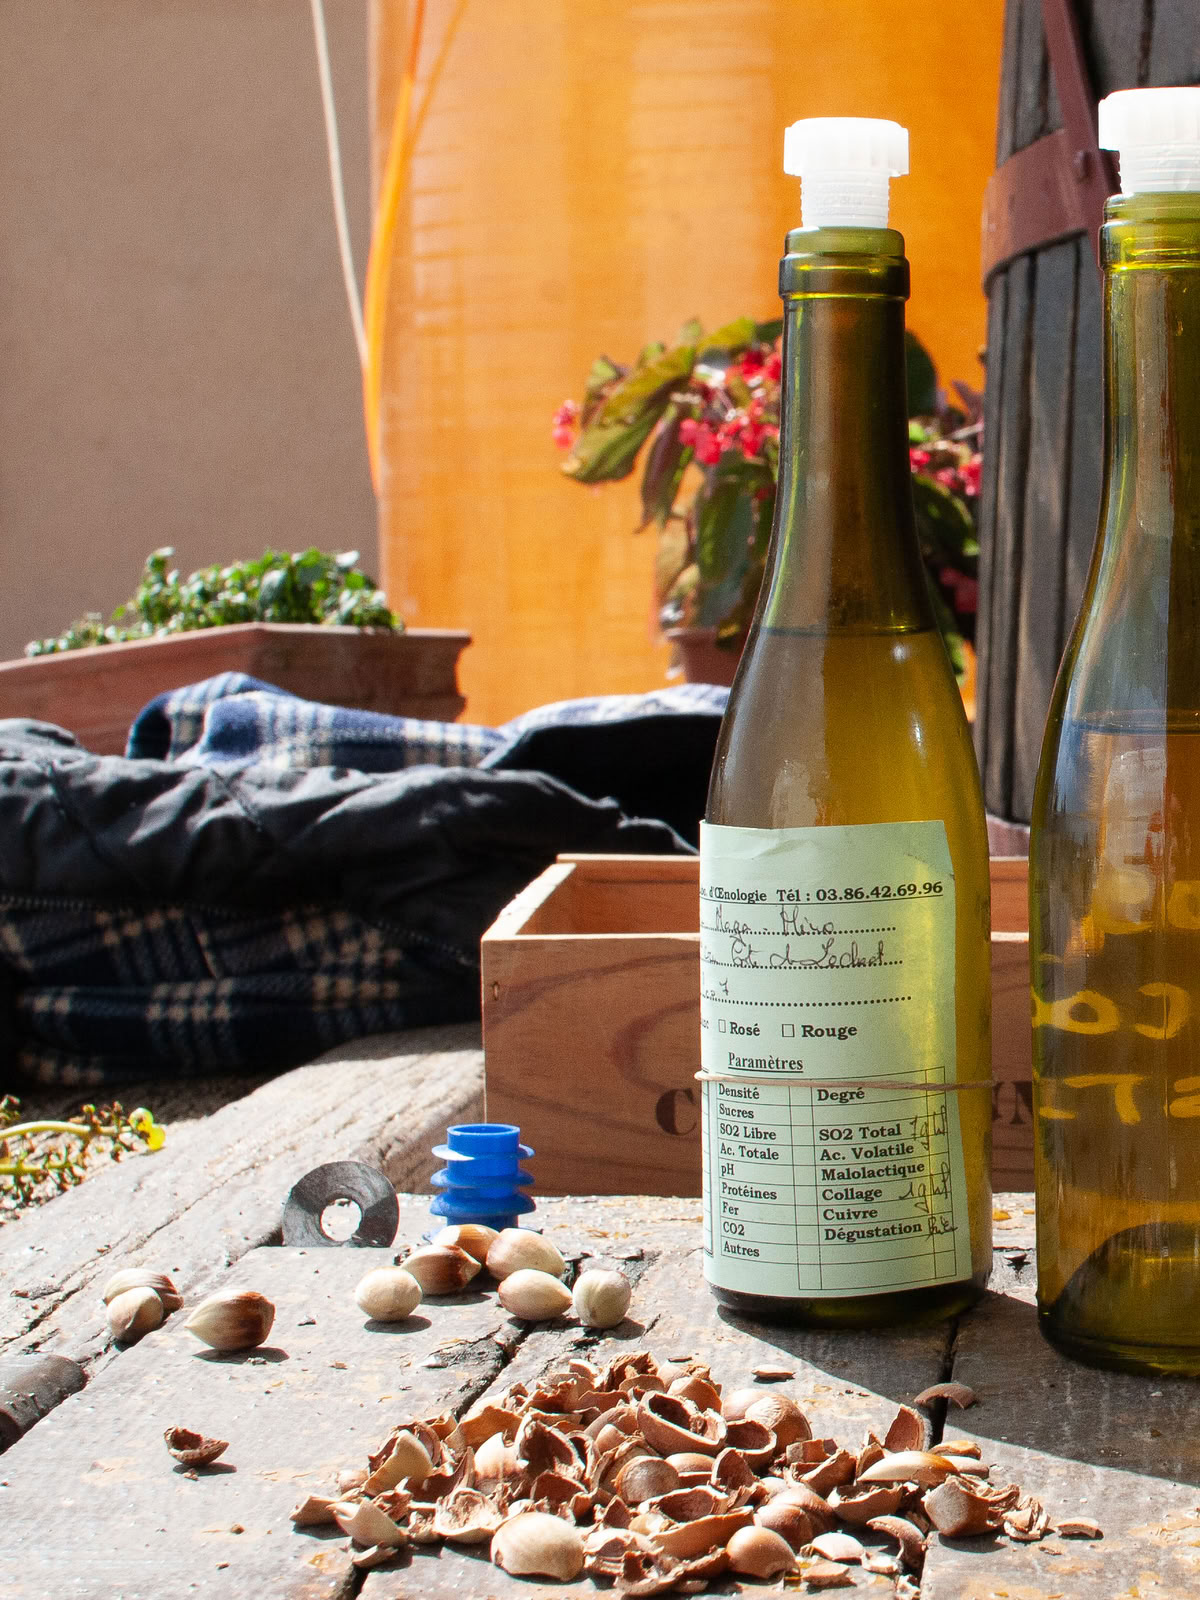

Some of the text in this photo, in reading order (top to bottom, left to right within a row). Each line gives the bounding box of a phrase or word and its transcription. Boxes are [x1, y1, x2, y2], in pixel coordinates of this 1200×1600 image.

[776, 889, 801, 902] Tél
[816, 881, 943, 902] 03.86.42.69.96
[729, 1021, 760, 1037] Rosé
[801, 1024, 857, 1041] Rouge
[728, 1051, 804, 1071] Paramètres
[718, 1083, 760, 1100] Densité
[817, 1087, 865, 1103] Degré
[719, 1103, 754, 1119] Sucres
[720, 1122, 777, 1141] SO2 Libre
[819, 1123, 902, 1141] SO2 Total
[720, 1142, 780, 1160] Ac. Totale
[820, 1143, 914, 1161] Ac. Volatile
[721, 1162, 735, 1176] pH
[821, 1163, 925, 1181] Malolactique
[721, 1181, 778, 1200] Protéines
[822, 1188, 883, 1202] Collage
[722, 1200, 740, 1216] Fer
[823, 1208, 879, 1221] Cuivre
[722, 1220, 746, 1236] CO2
[824, 1221, 923, 1243] Dégustation
[723, 1240, 761, 1258] Autres
